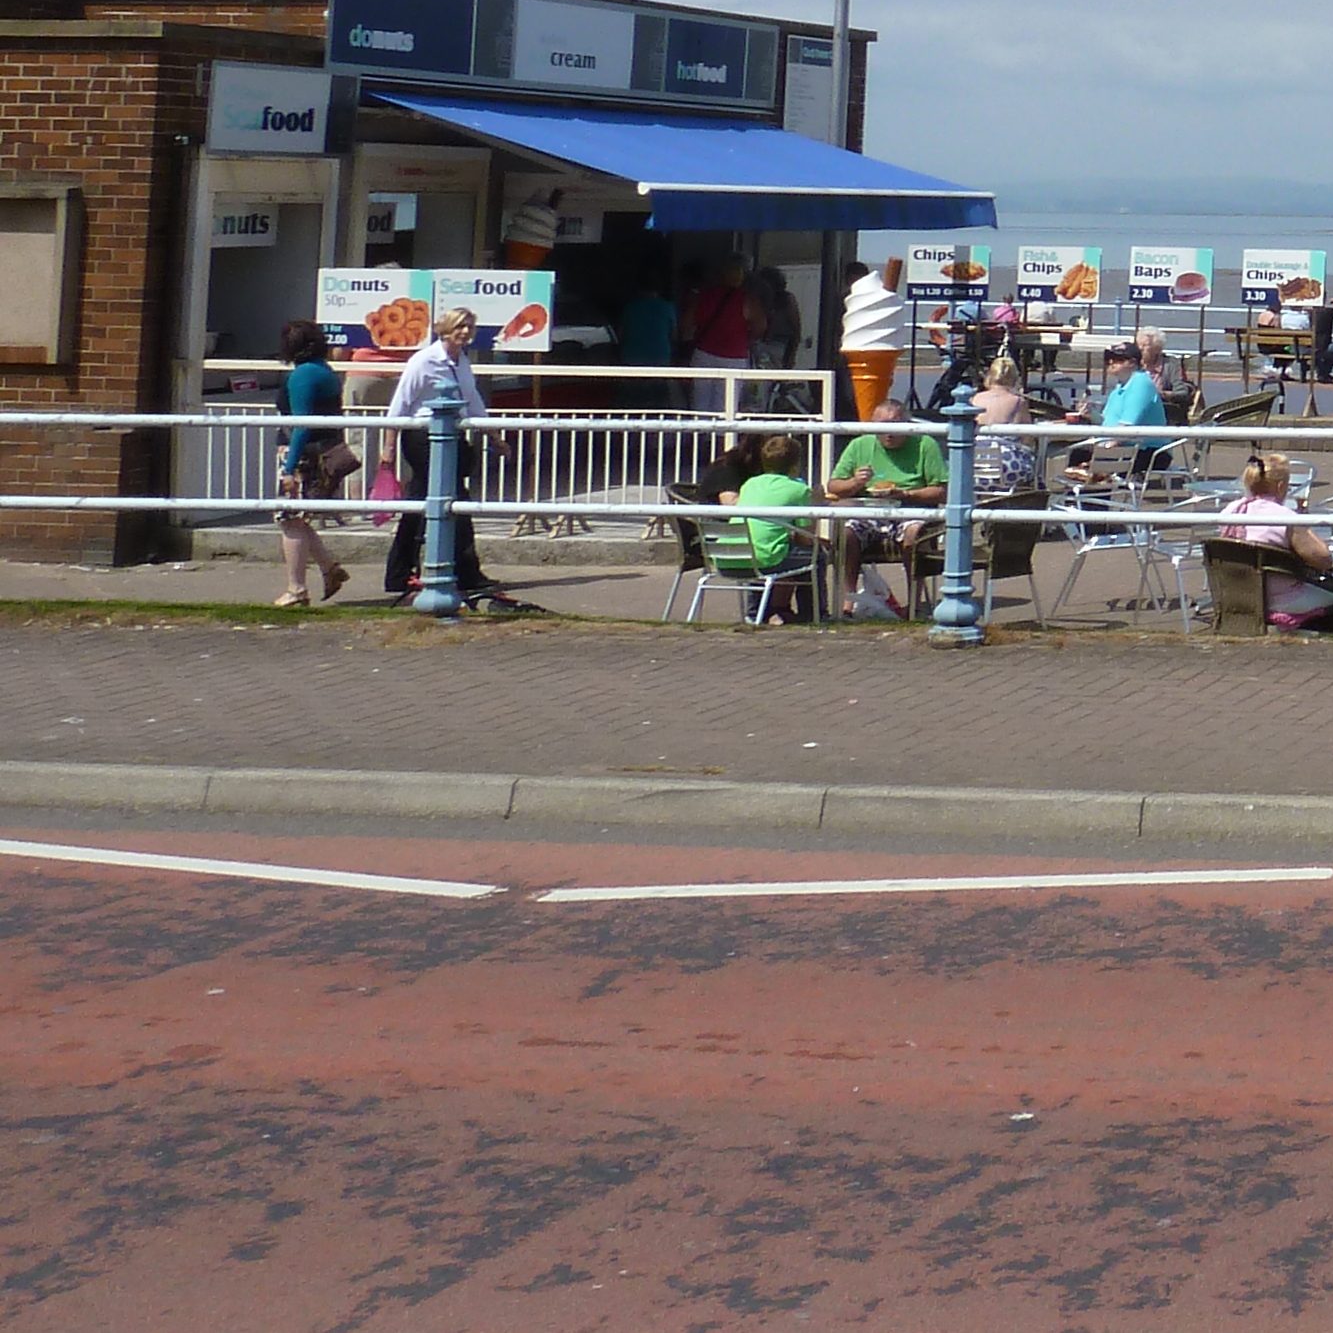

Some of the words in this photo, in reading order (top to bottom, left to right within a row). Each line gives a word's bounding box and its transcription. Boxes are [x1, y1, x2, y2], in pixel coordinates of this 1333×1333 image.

[350, 24, 415, 53] donuts
[550, 49, 596, 70] cream
[913, 248, 955, 262] Chips
[1135, 252, 1179, 265] Bacon
[1023, 262, 1062, 275] Chips
[1134, 265, 1172, 279] Baps
[1246, 269, 1285, 282] Chips
[323, 276, 390, 292] Donuts
[440, 277, 522, 296] Seafood
[1020, 288, 1041, 298] 4.40
[1132, 289, 1154, 299] 2.30
[1245, 290, 1267, 301] 3.30
[325, 294, 346, 308] 50p
